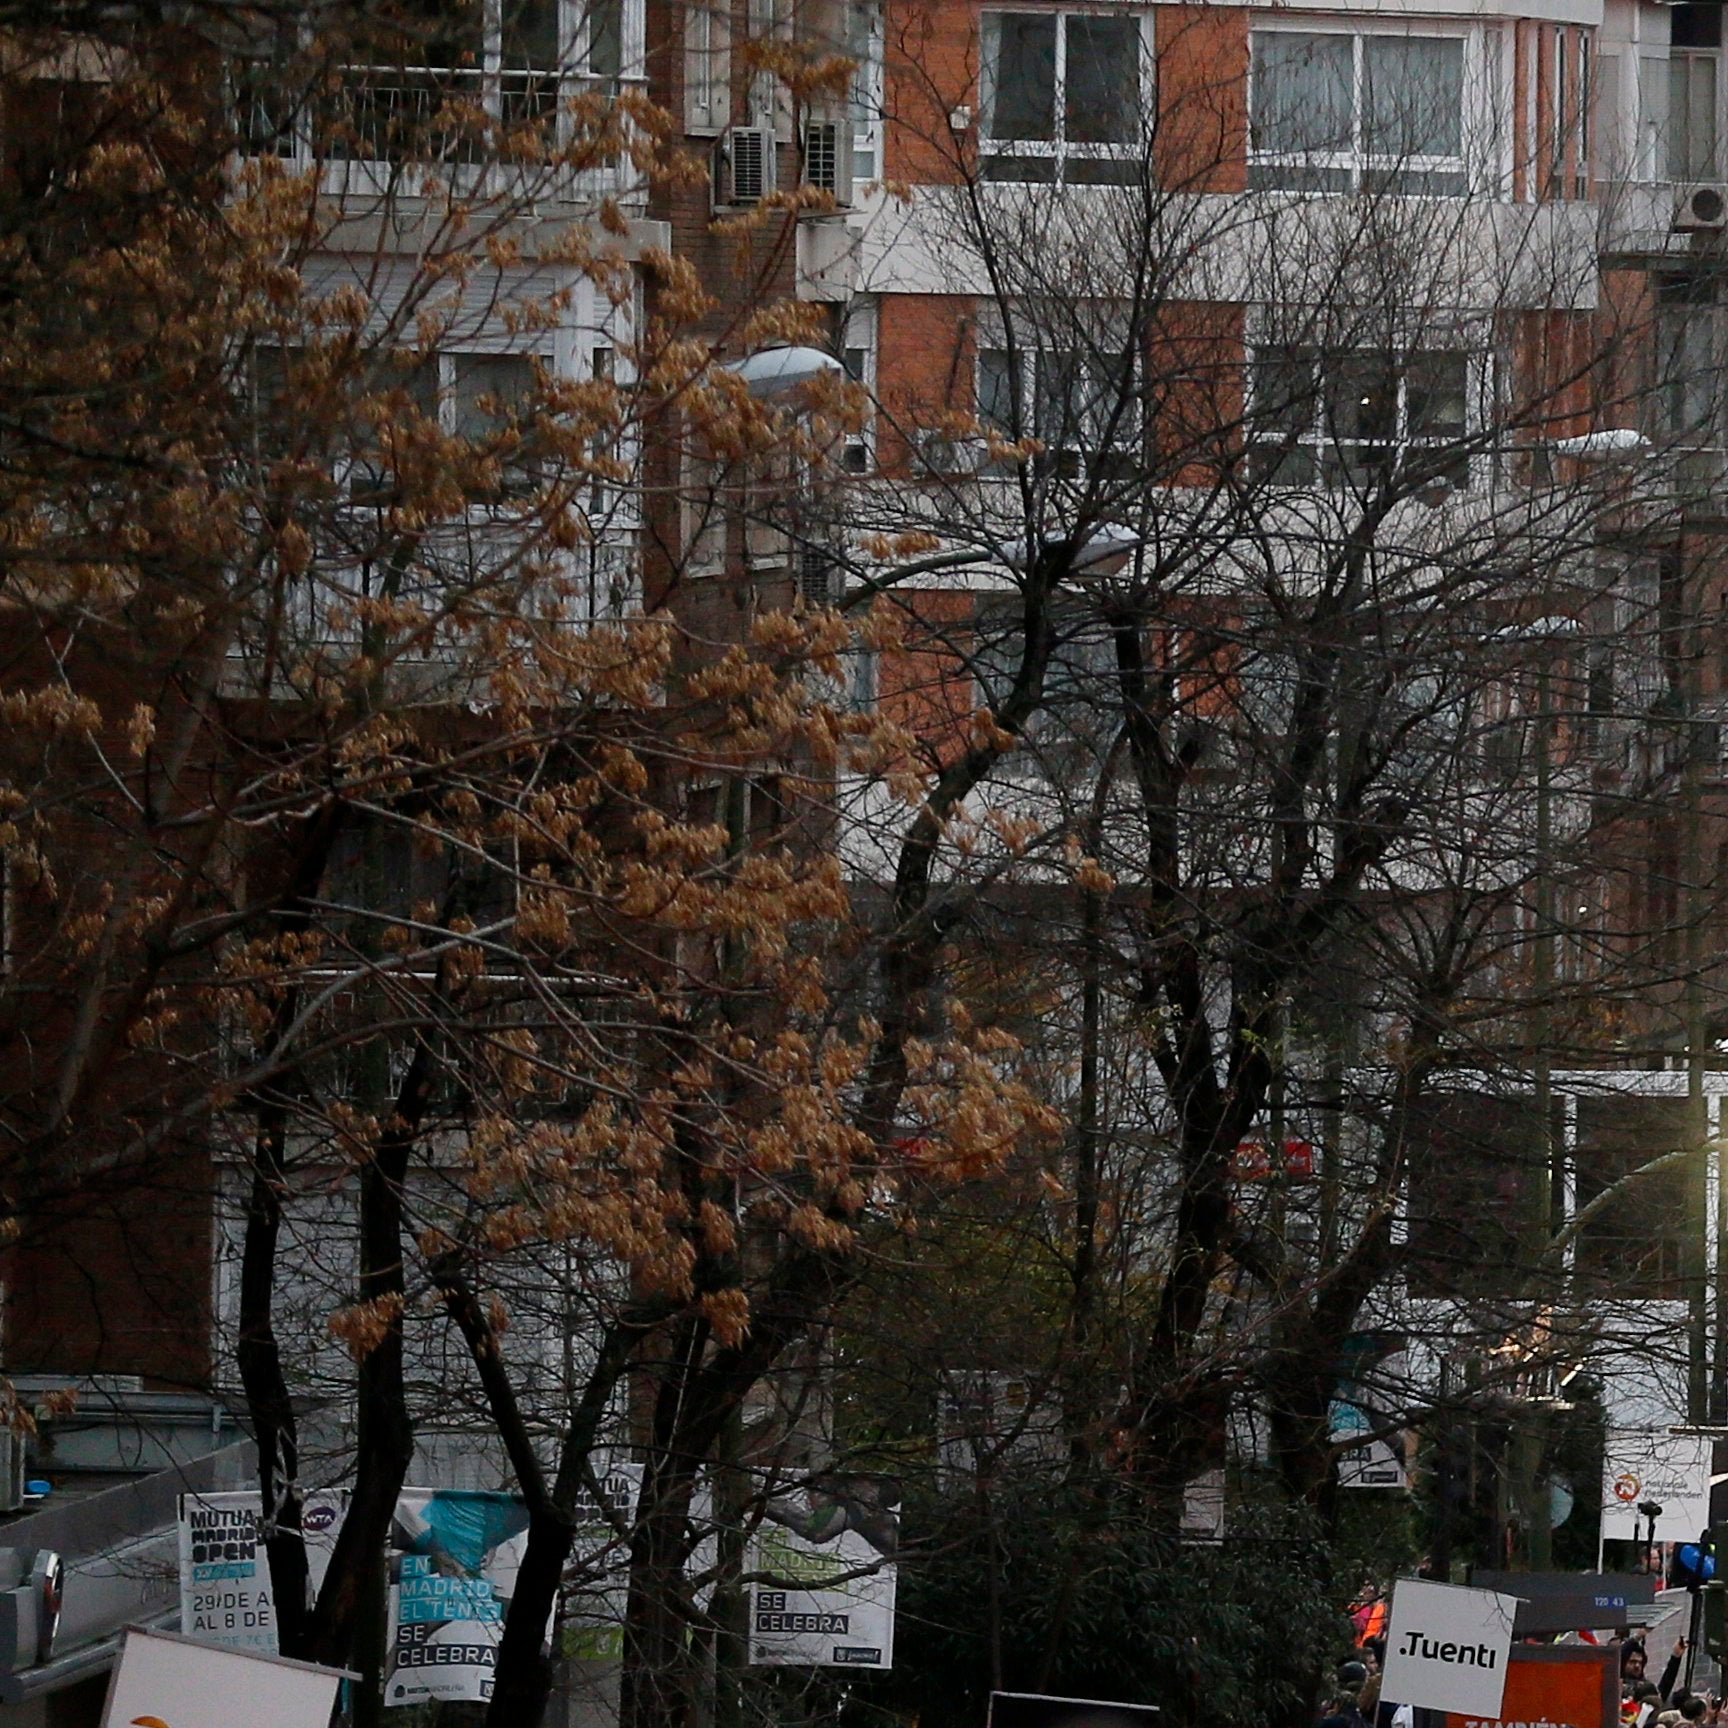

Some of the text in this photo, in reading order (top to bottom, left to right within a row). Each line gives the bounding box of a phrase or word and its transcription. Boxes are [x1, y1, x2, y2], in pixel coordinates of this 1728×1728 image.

[190, 1509, 257, 1528] MUTUA
[192, 1543, 256, 1563] OPEN
[402, 1557, 429, 1575] EN
[401, 1579, 490, 1596] MADRID
[224, 1593, 250, 1609] DE
[760, 1594, 783, 1608] SE
[401, 1604, 423, 1619] EL
[194, 1611, 269, 1631] AL 8 DE
[758, 1615, 846, 1632] CELEBRA
[400, 1625, 425, 1643] SE
[397, 1647, 495, 1666] CELEBRA
